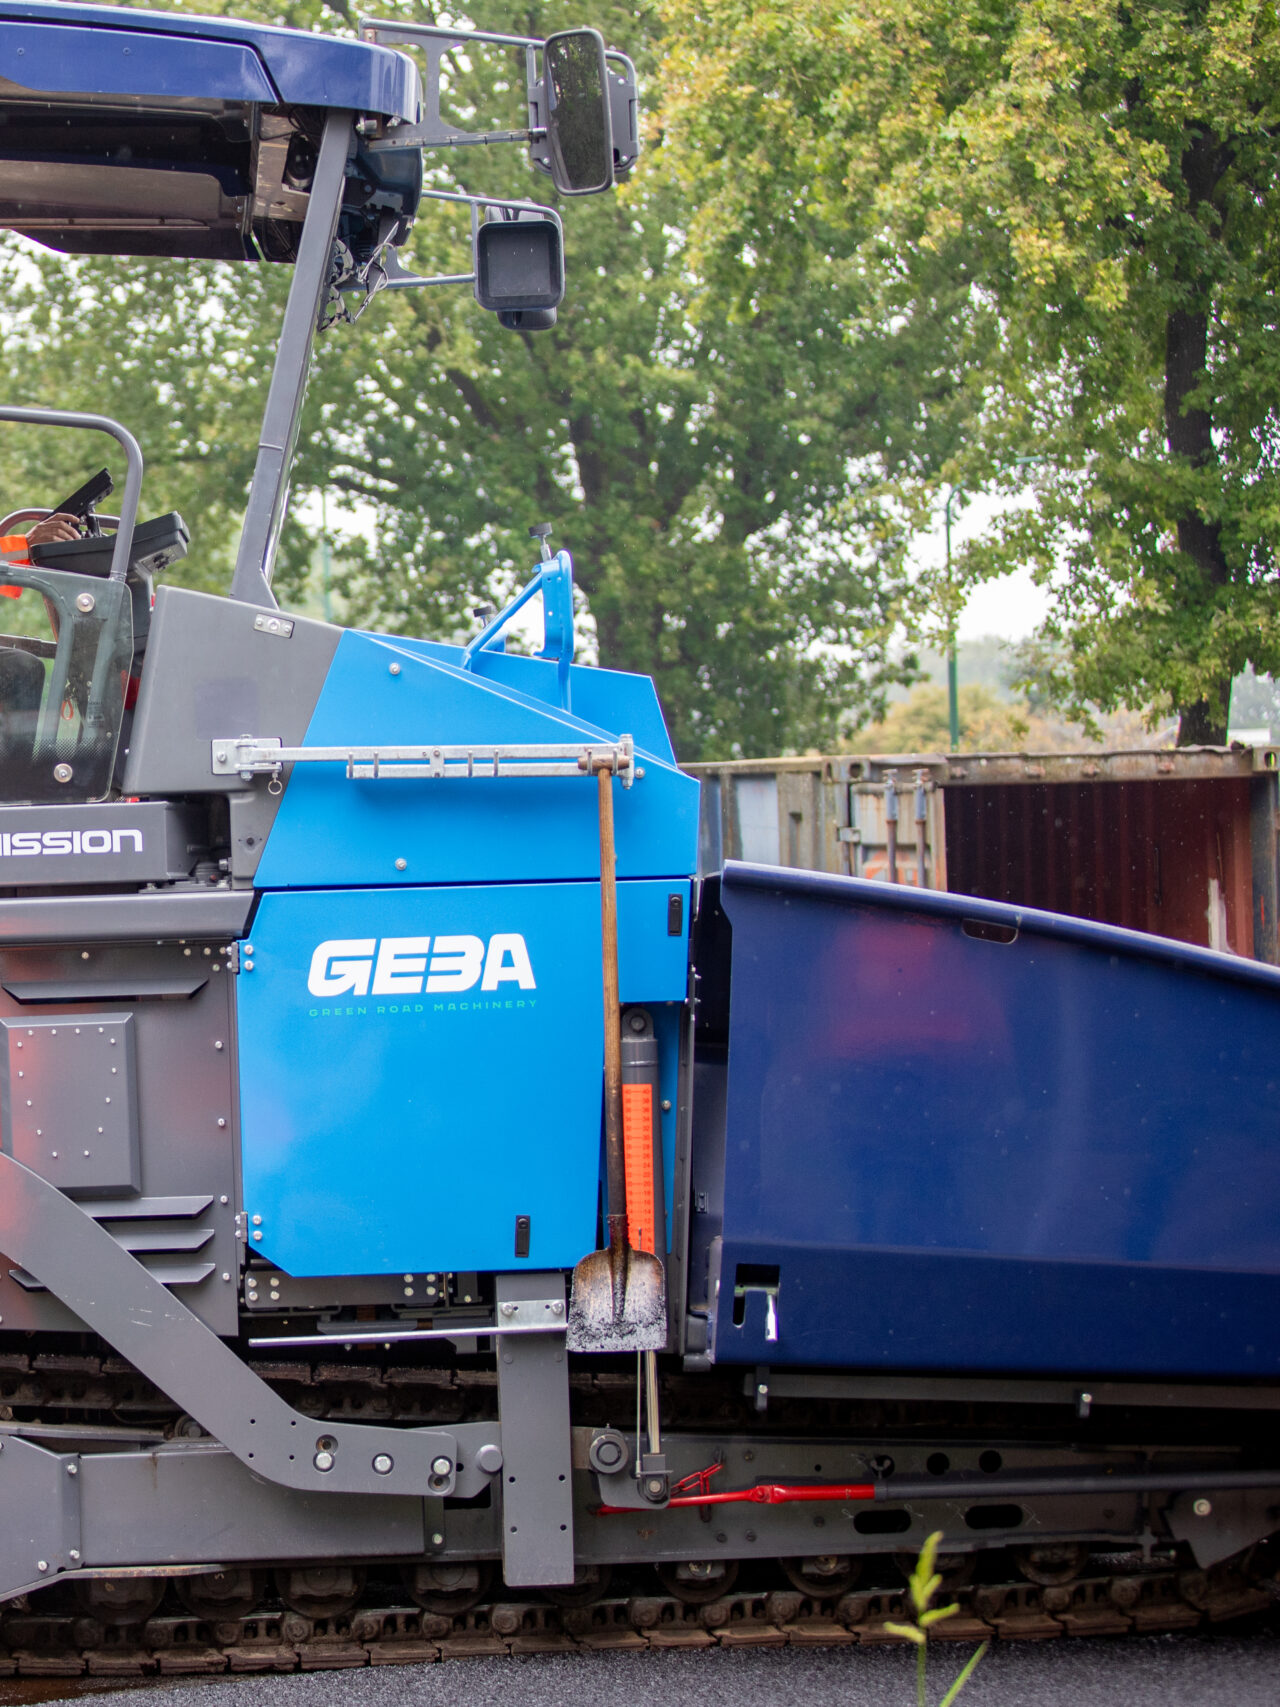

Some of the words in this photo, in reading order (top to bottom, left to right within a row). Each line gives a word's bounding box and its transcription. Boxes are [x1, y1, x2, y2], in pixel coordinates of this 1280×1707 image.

[307, 933, 537, 997] GEBA
[308, 1007, 368, 1017] GREEN
[376, 1004, 424, 1014] ROAD
[433, 999, 538, 1012] MACHINERY
